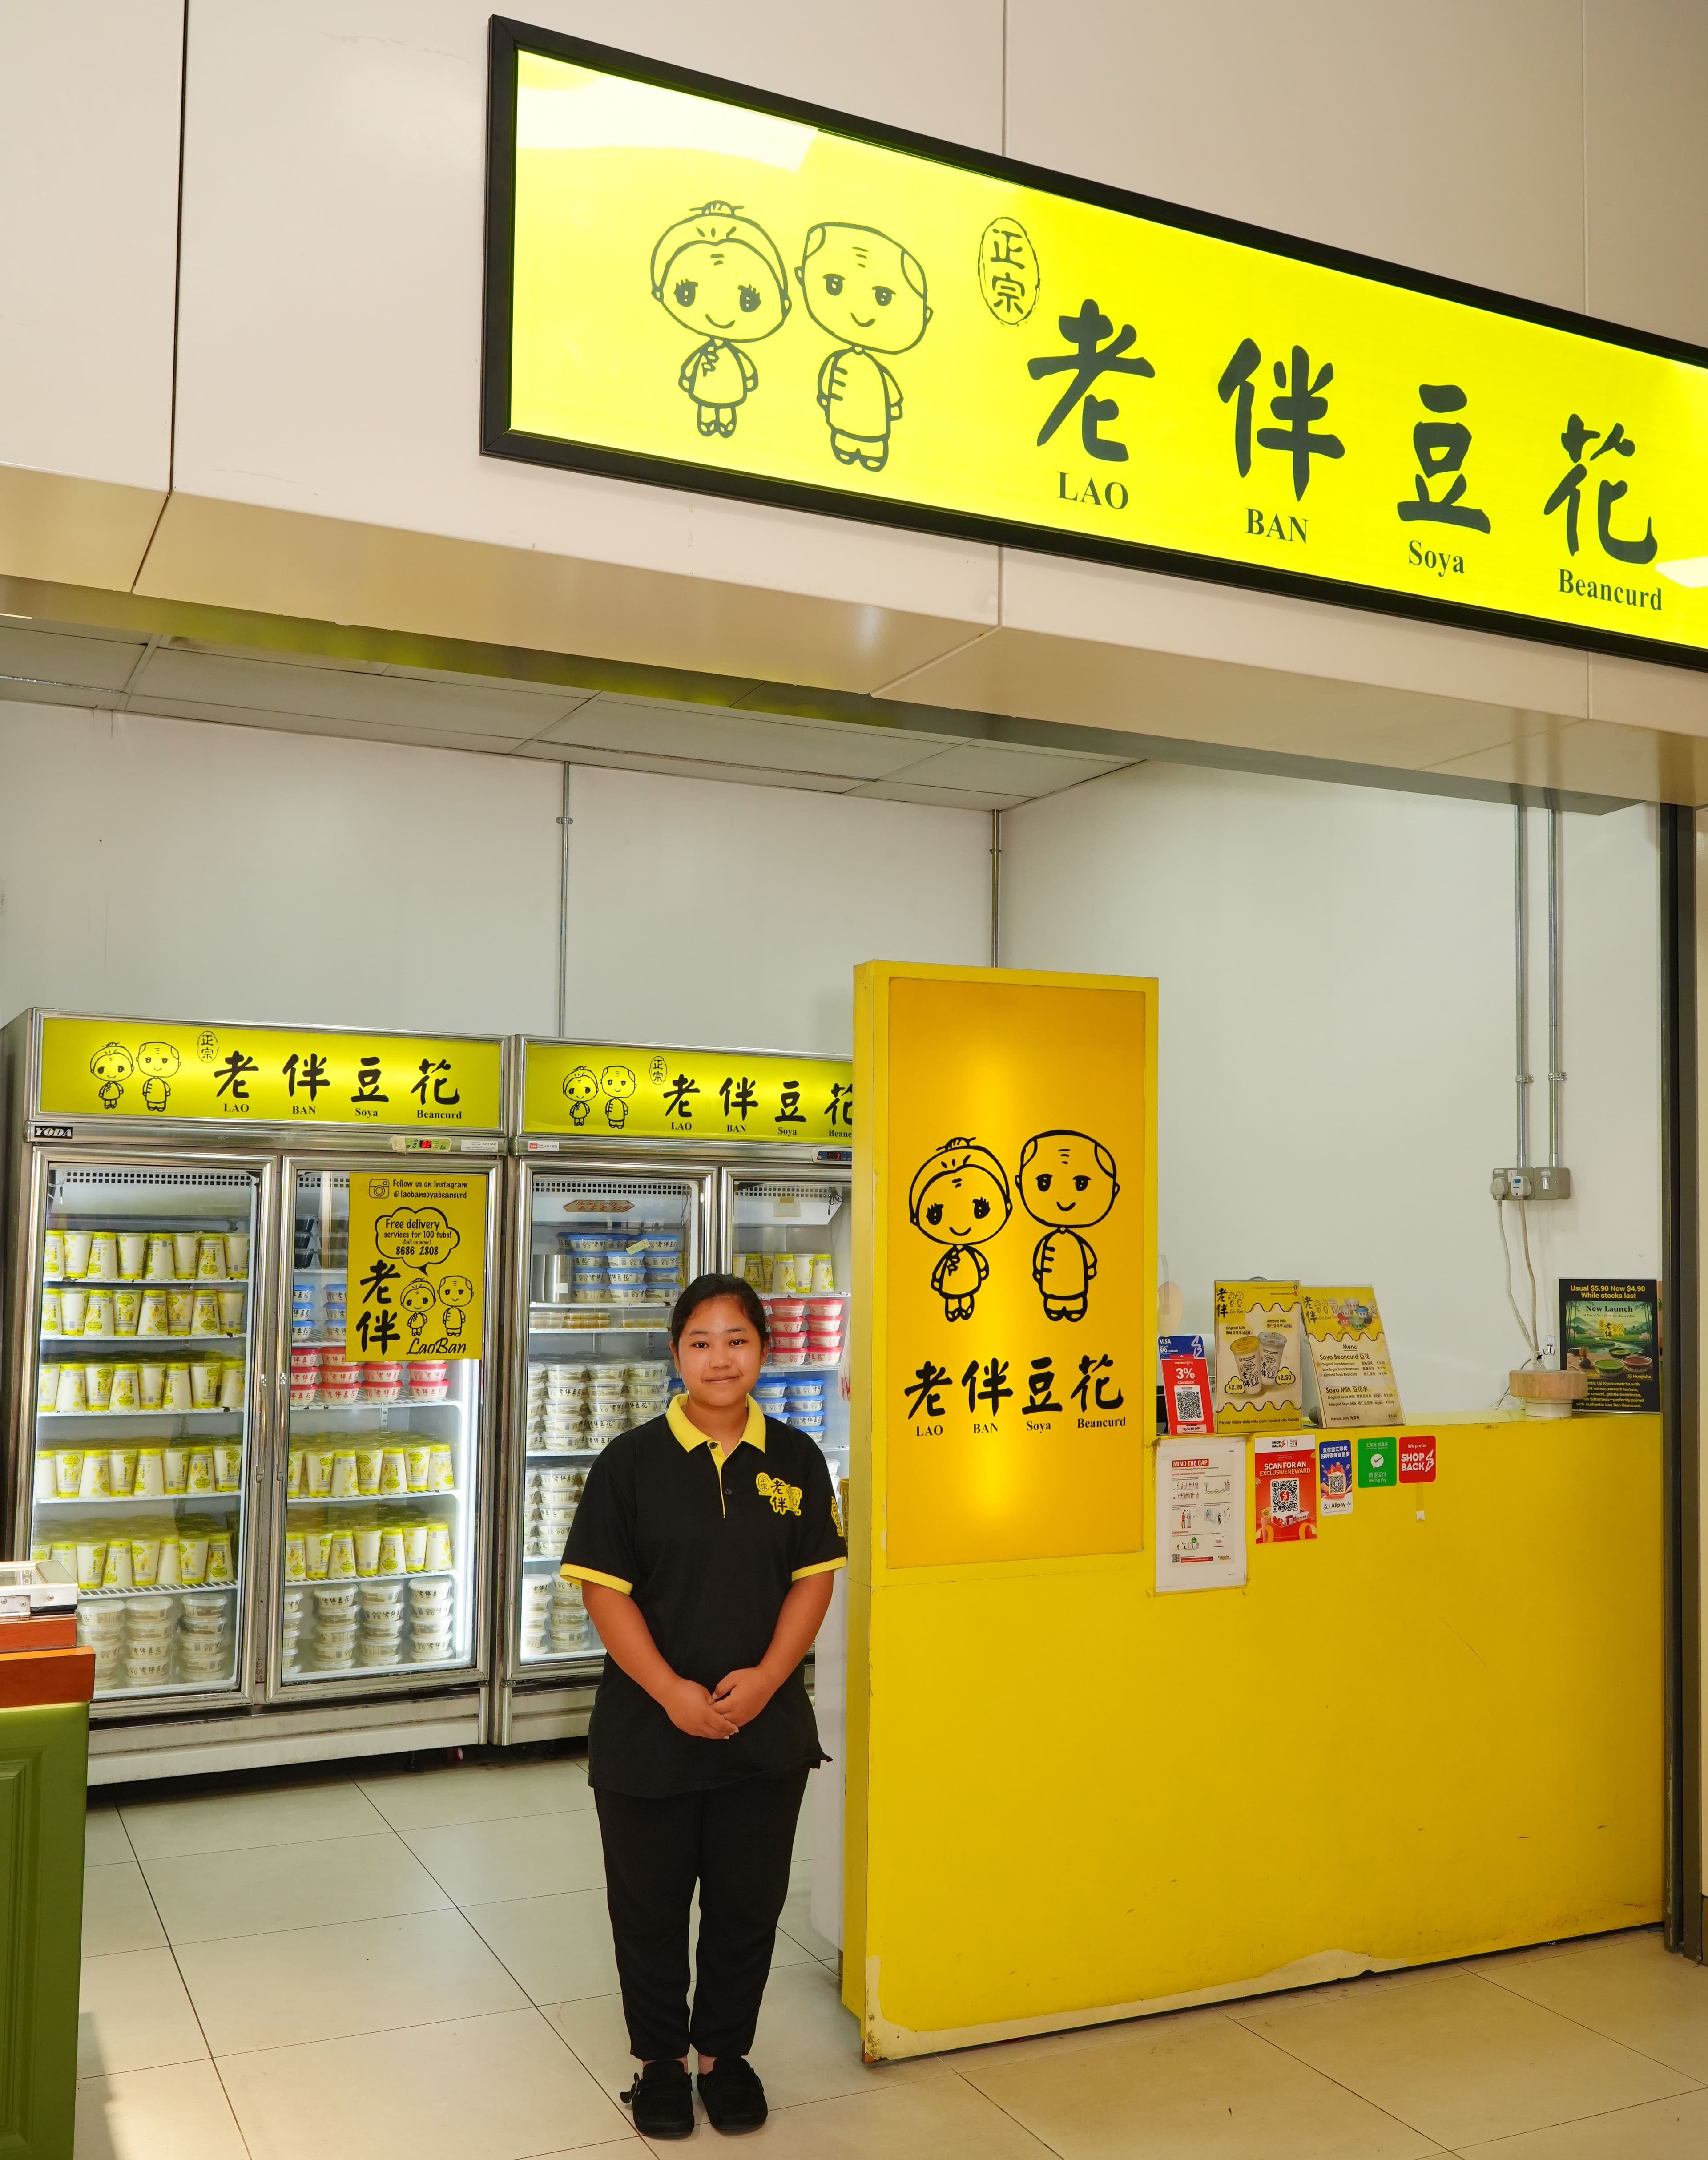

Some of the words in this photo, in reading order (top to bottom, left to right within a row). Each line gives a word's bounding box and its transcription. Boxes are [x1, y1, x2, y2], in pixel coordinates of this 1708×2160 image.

[990, 229, 1027, 312] 正宗
[1028, 299, 1658, 564] 老伴豆花
[1059, 472, 1129, 509] LAO
[1246, 508, 1308, 544] BAN
[1409, 540, 1465, 577] Soya
[1559, 569, 1662, 610] Beancurd
[201, 1034, 214, 1059] 正宗
[214, 1050, 460, 1106] 老伴豆花
[224, 1103, 249, 1112] LAO
[292, 1106, 316, 1114] BAN
[355, 1108, 378, 1118] Soya
[417, 1110, 462, 1119] Beancurd
[34, 1126, 73, 1138] YODA
[671, 1122, 693, 1130] LAO
[727, 1124, 746, 1133] BAN
[778, 1127, 797, 1137] Soya
[829, 1129, 852, 1138] Beanc
[434, 1180, 467, 1189] Instagram
[386, 1219, 404, 1229] Free
[407, 1219, 440, 1231] delivery
[395, 1246, 415, 1256] 8686
[419, 1246, 439, 1256] 2808
[356, 1259, 401, 1356] 老伴
[1216, 1287, 1229, 1319] 老伴
[406, 1337, 467, 1355] LaoBan
[1176, 1367, 1195, 1379] 3%
[904, 1354, 1124, 1420] 老伴豆花
[916, 1425, 943, 1437] LAO
[973, 1423, 998, 1433] BAN
[1027, 1421, 1051, 1433] Soya
[1077, 1416, 1126, 1429] Beancurd
[1401, 1453, 1425, 1462] SHOP
[1401, 1462, 1425, 1471] BACK
[760, 1477, 768, 1490] 正宗
[770, 1480, 788, 1512] 老伴
